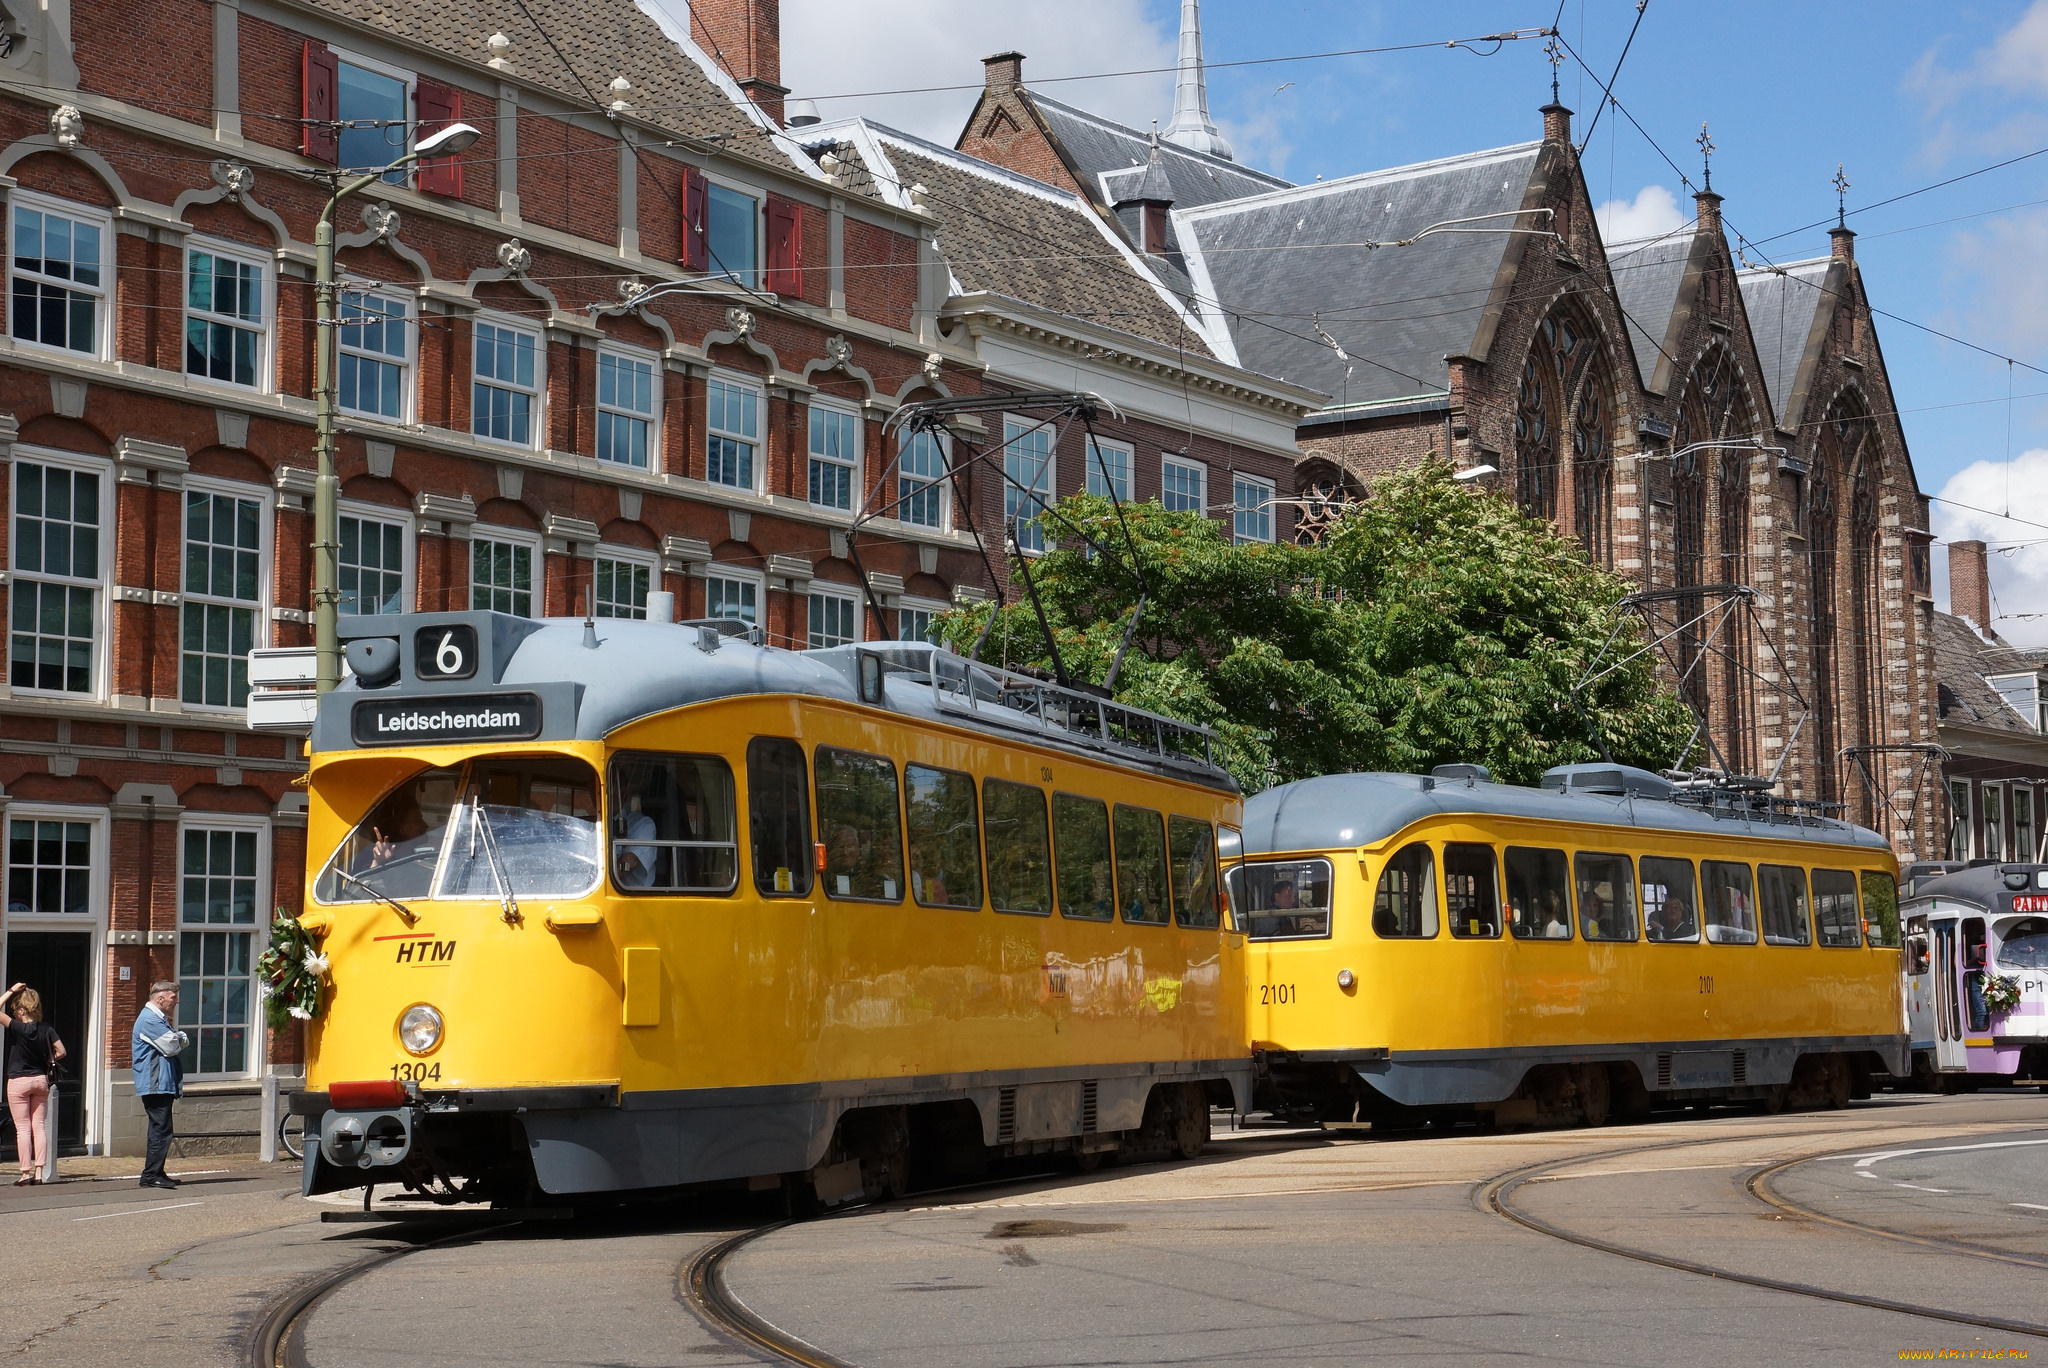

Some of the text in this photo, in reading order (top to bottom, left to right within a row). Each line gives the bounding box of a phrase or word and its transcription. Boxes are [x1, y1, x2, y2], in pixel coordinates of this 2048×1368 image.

[436, 630, 463, 674] 6
[378, 709, 520, 732] Leidschendam
[1040, 766, 1053, 783] 1304
[396, 941, 456, 963] HTM
[121, 970, 130, 979] 24
[1699, 976, 1714, 993] 2101
[1260, 984, 1296, 1005] 2101
[390, 1062, 441, 1082] 1304
